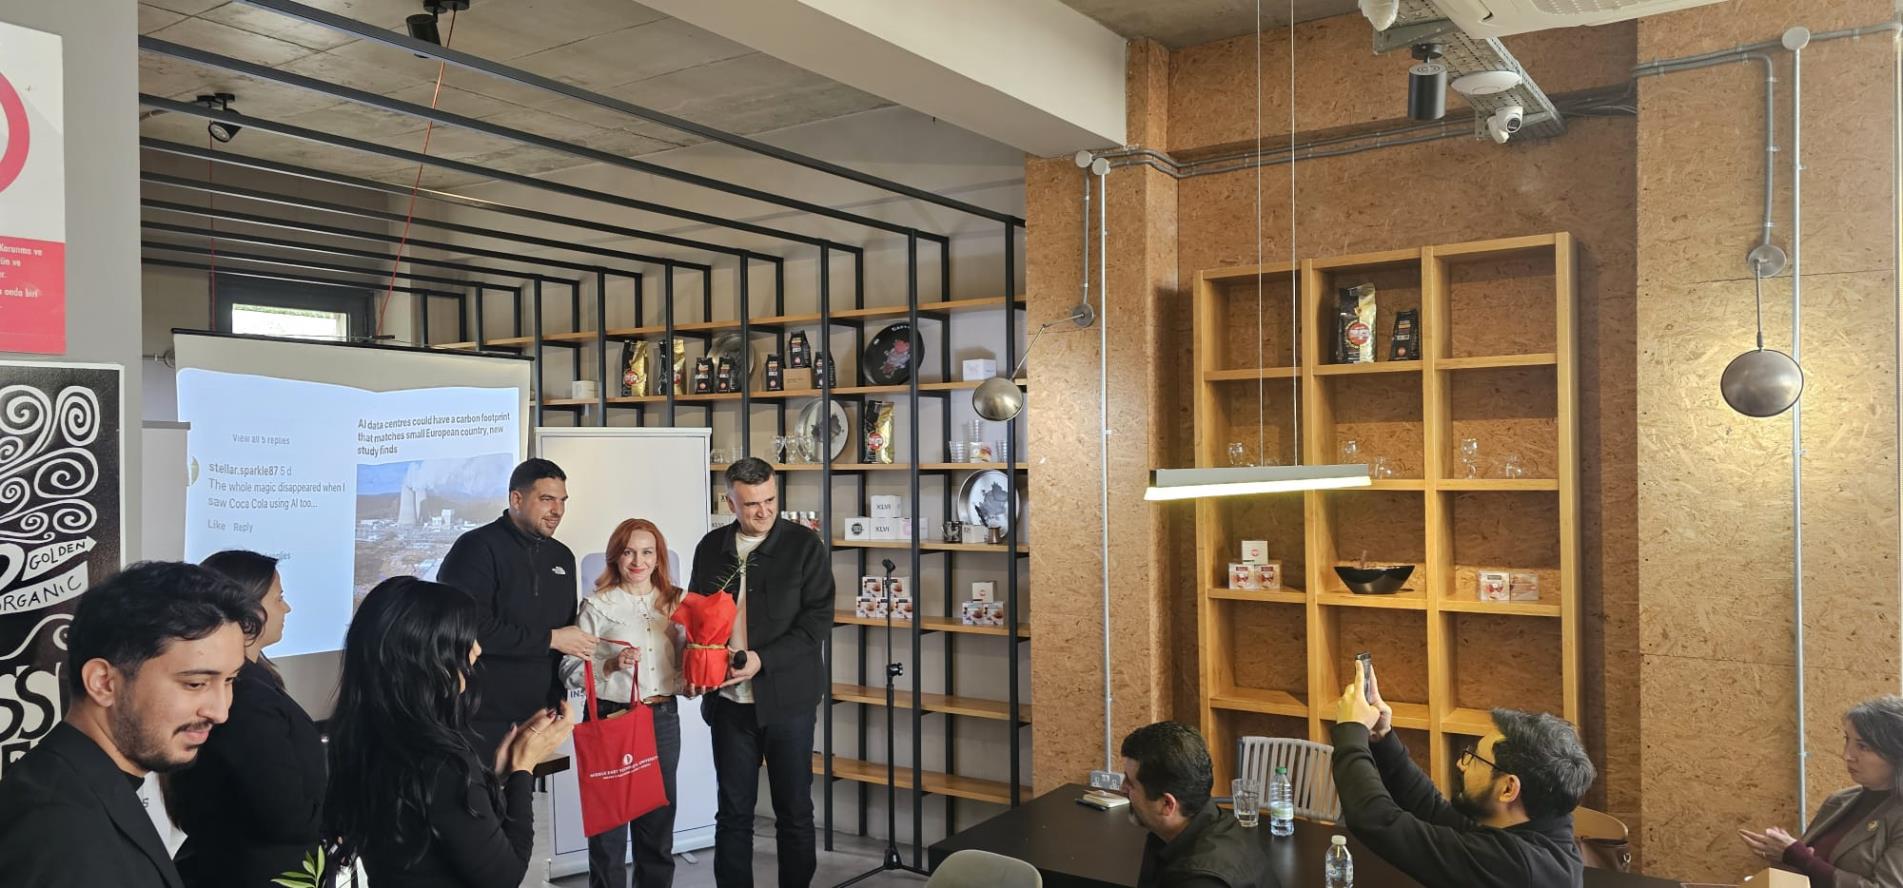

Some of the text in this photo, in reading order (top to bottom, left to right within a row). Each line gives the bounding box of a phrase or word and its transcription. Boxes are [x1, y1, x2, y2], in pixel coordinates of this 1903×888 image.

[367, 419, 383, 430] data
[384, 418, 411, 429] centres
[412, 415, 432, 426] could
[433, 415, 450, 424] have
[456, 413, 480, 424] carbon
[481, 412, 510, 423] footprint
[232, 433, 251, 443] View
[251, 435, 260, 443] all
[267, 436, 290, 445] replies
[358, 432, 373, 443] that
[374, 431, 405, 443] matches
[406, 428, 425, 439] small
[426, 427, 459, 439] European
[489, 426, 504, 434] new
[357, 444, 398, 458] study finds
[208, 477, 226, 491] The
[229, 481, 252, 493] whole
[254, 482, 276, 495] magic
[279, 481, 321, 495] disappeared
[322, 481, 341, 493] when
[208, 497, 226, 507] saw
[228, 497, 249, 509] Coca
[251, 498, 268, 509] Cola
[269, 498, 289, 510] using
[207, 519, 226, 531] Like
[233, 521, 254, 533] Reply
[29, 541, 86, 570] GOLDEN
[0, 575, 82, 611] RGANIC
